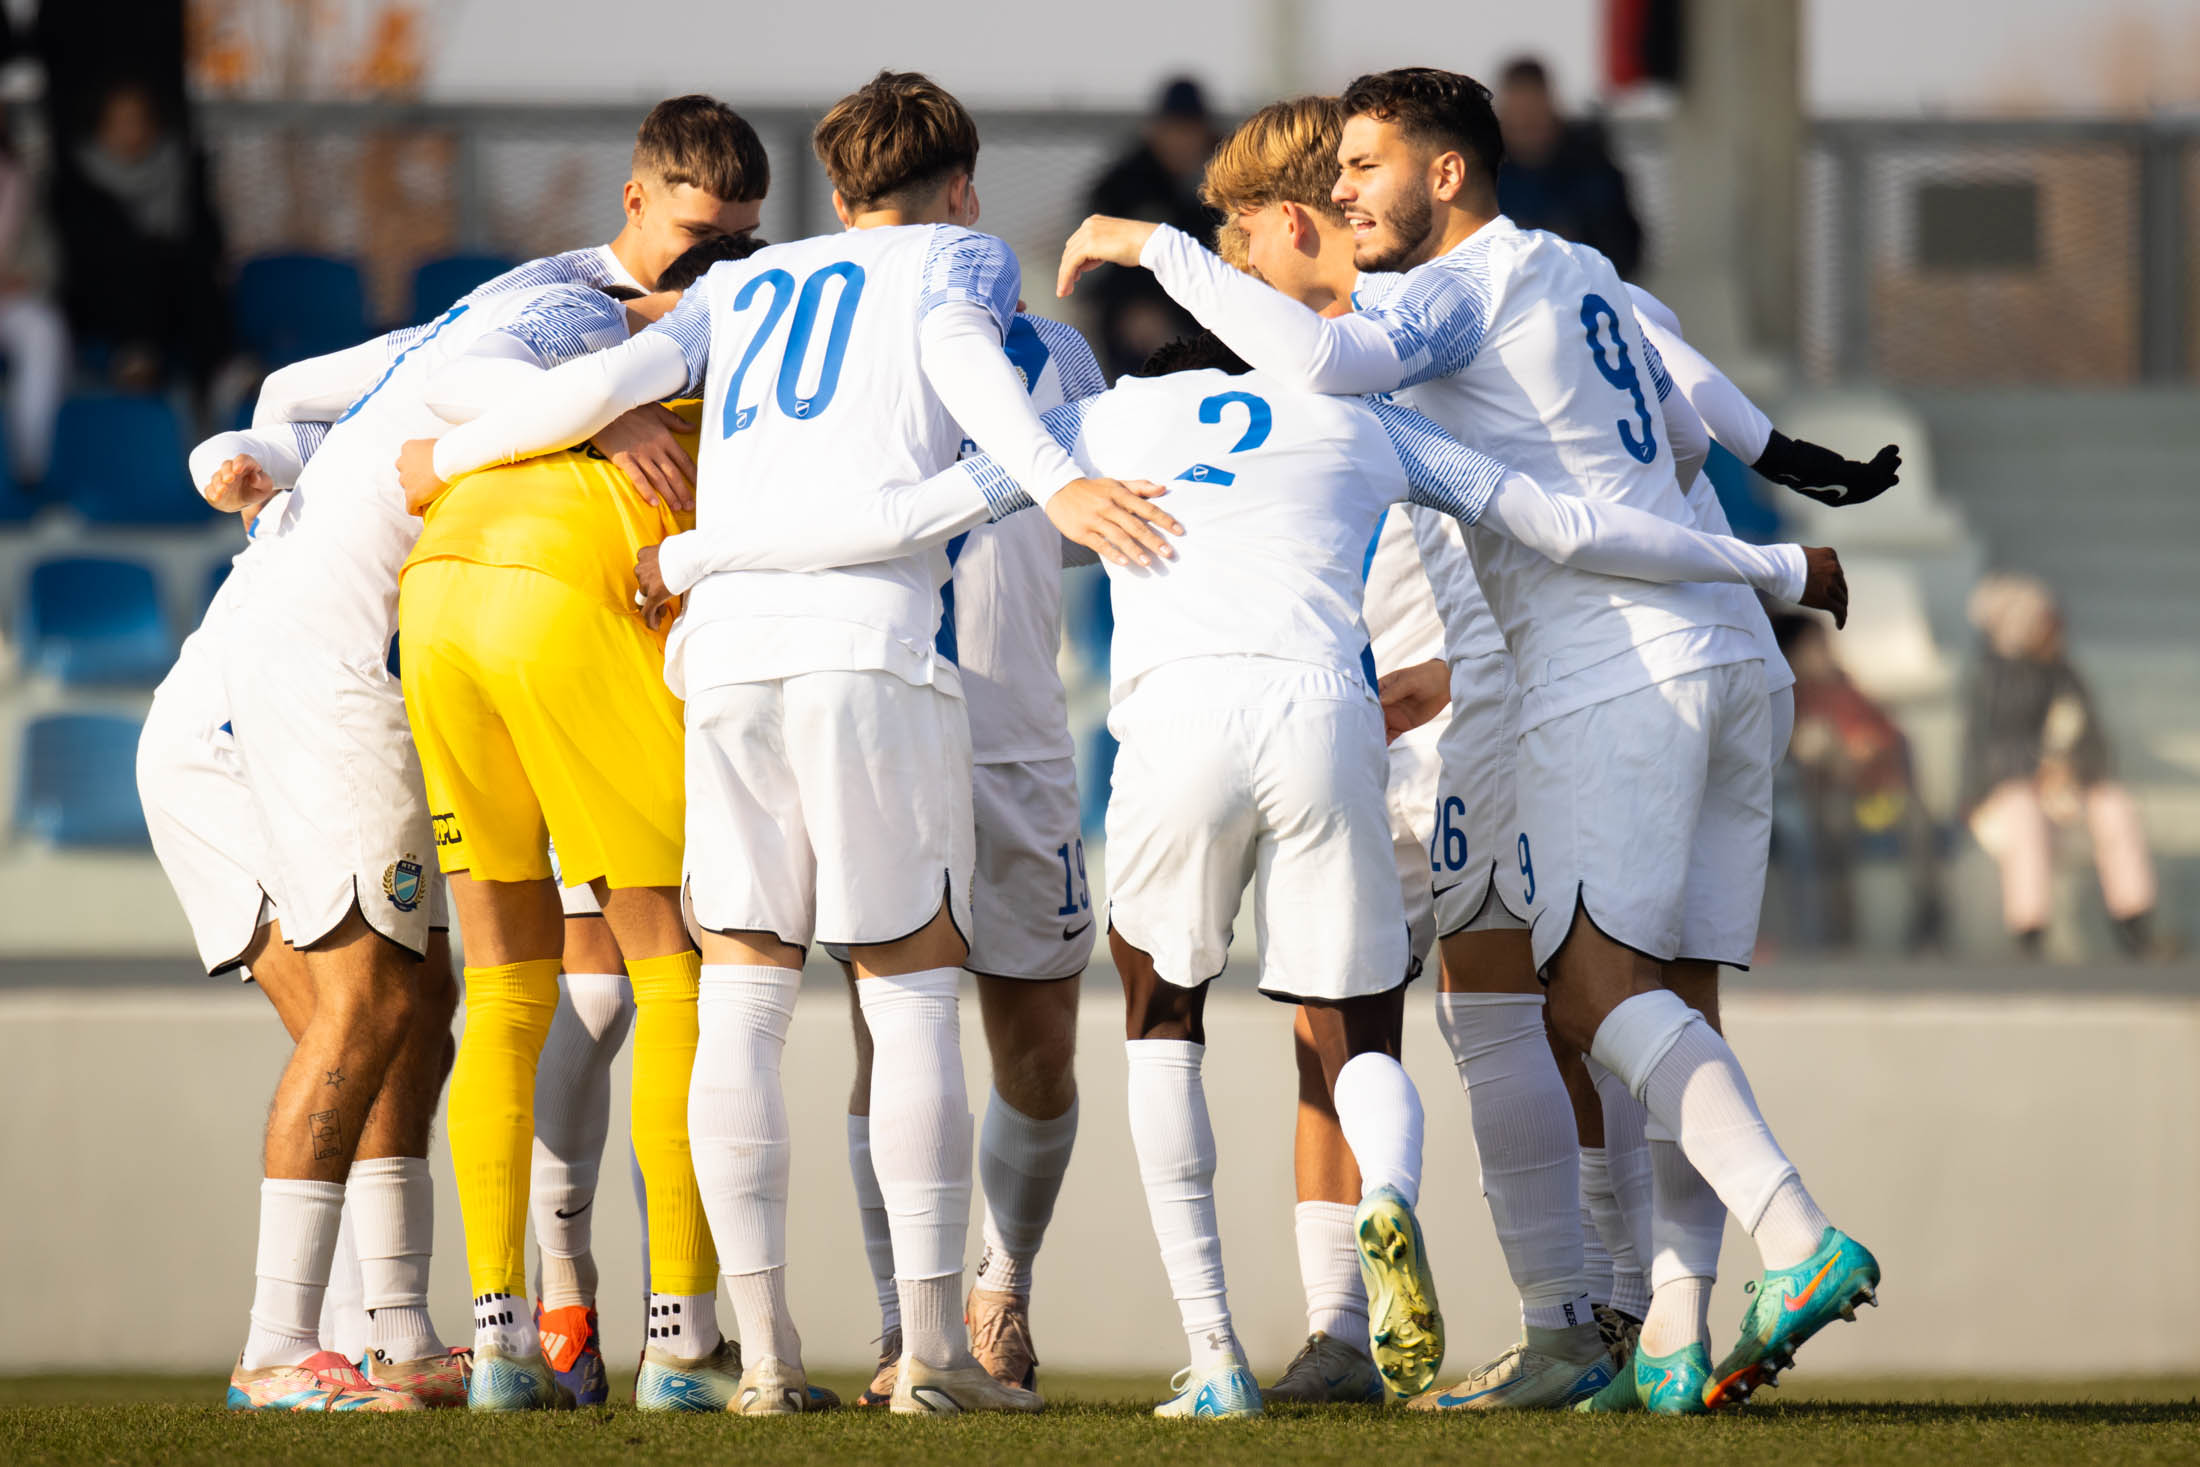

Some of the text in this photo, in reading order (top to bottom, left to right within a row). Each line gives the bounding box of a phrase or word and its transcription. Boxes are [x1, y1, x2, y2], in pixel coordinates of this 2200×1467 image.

[723, 261, 865, 440] 20
[1580, 293, 1657, 465] 9
[1173, 391, 1272, 487] 2
[1057, 838, 1089, 916] 19
[1517, 832, 1536, 905] 9
